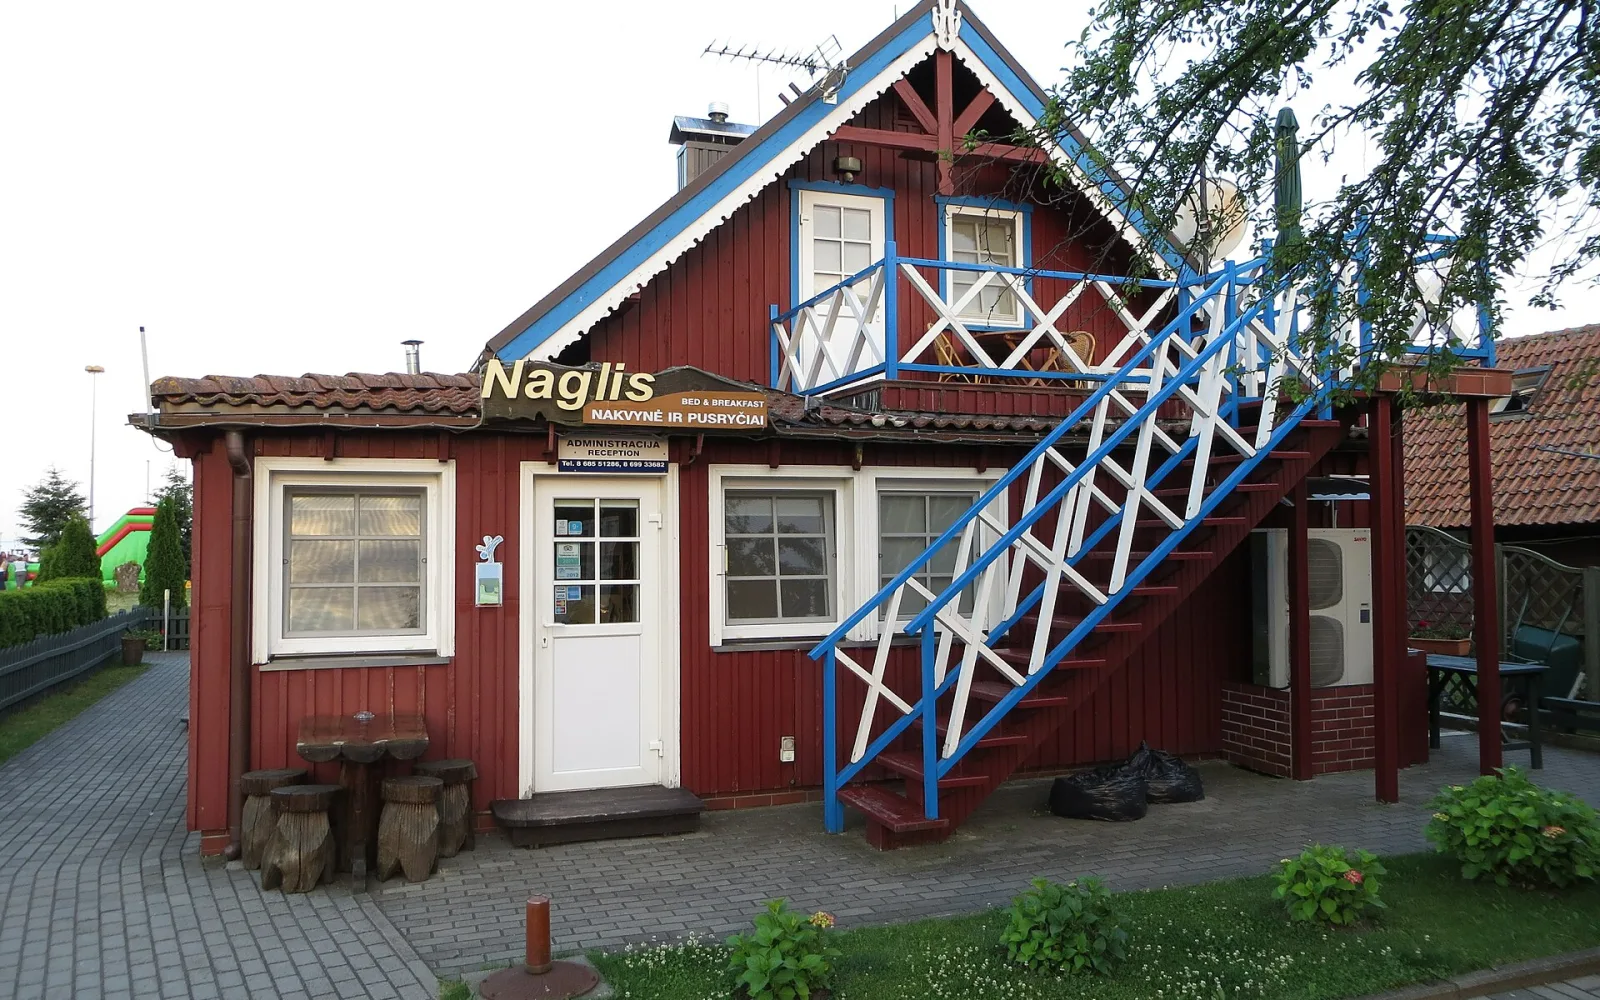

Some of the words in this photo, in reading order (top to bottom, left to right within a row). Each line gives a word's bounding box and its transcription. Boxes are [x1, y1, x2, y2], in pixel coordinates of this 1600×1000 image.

[481, 358, 656, 411] Naglis
[681, 397, 700, 406] BED
[703, 398, 709, 406] &
[711, 399, 765, 408] BREAKFAST
[591, 409, 663, 422] NAKVYNĖ
[668, 412, 682, 423] IR
[687, 412, 764, 426] PUSRYČIAI
[566, 439, 661, 449] ADMINISTRACIJA
[587, 449, 640, 457] RECEPTION
